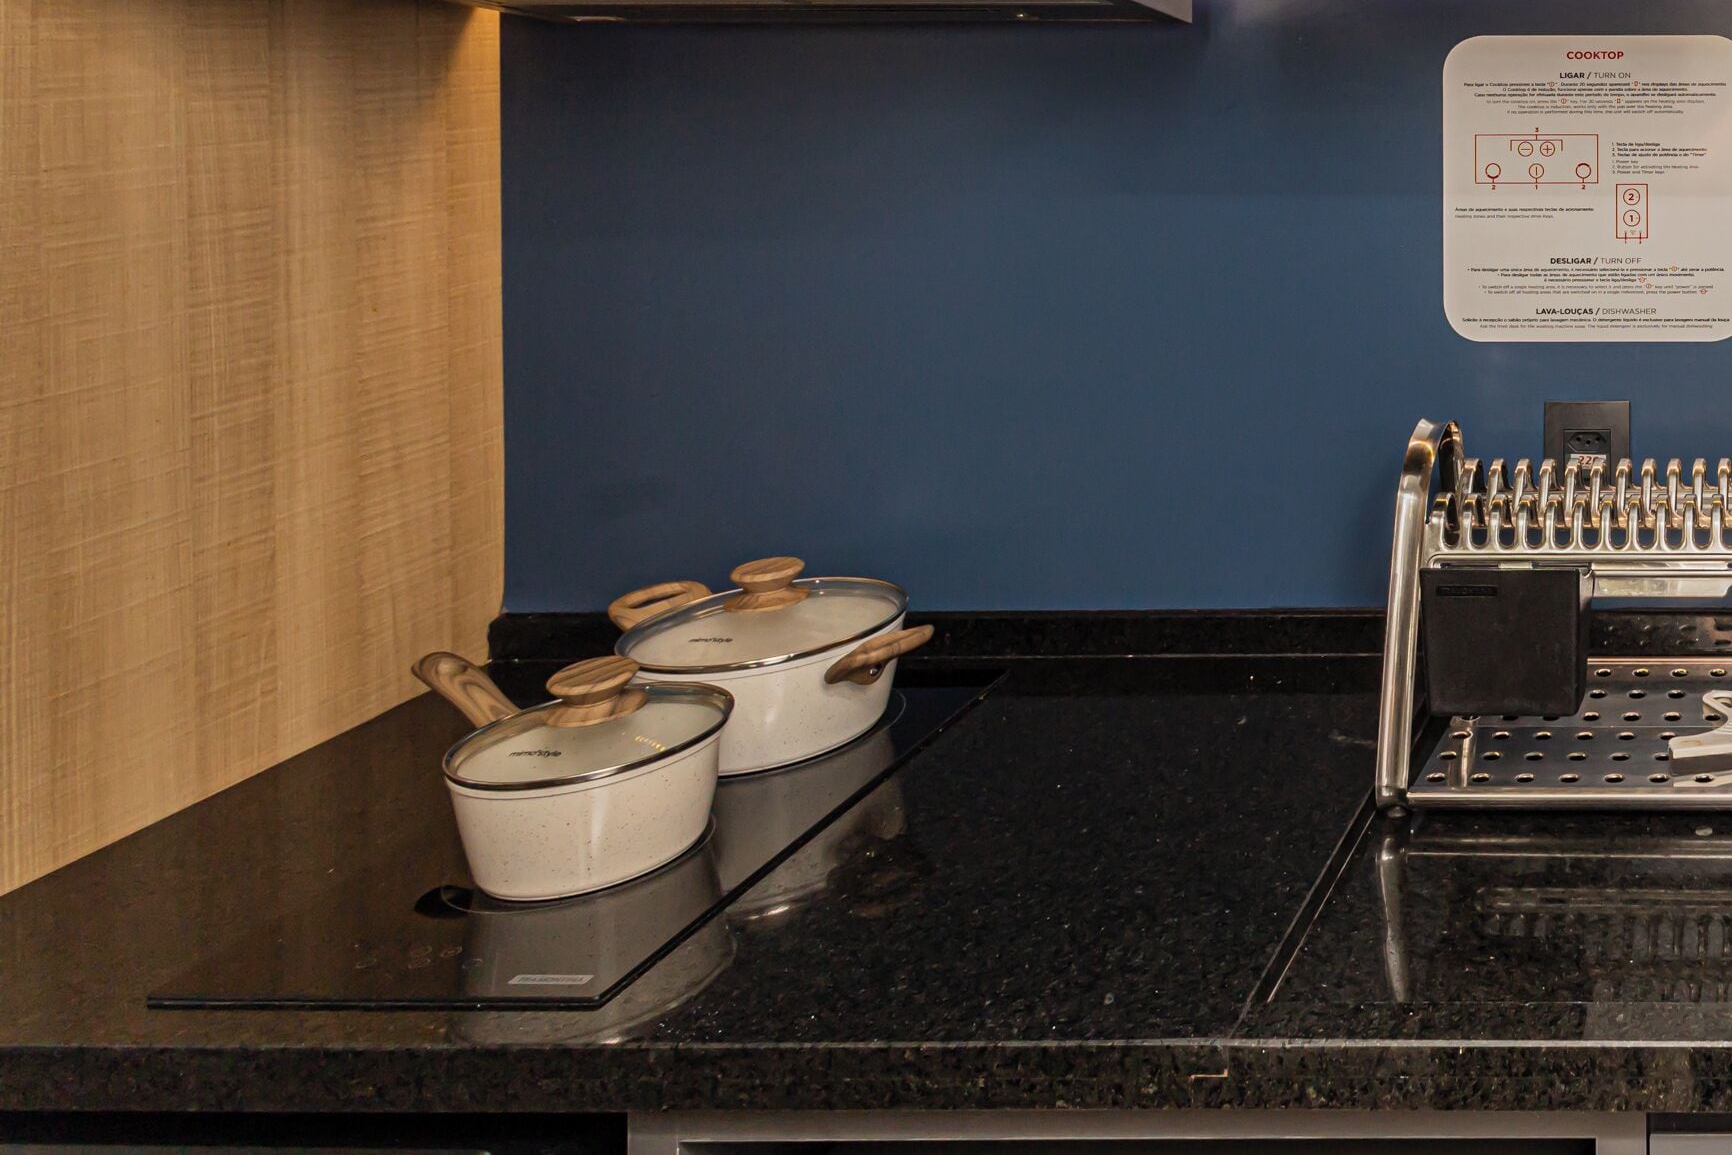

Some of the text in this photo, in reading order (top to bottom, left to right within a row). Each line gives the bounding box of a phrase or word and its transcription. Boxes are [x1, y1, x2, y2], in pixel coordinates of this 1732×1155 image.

[1566, 51, 1624, 60] COOKTOP
[1586, 72, 1592, 80] /
[1628, 193, 1635, 201] 2
[1593, 257, 1599, 265] /
[1536, 308, 1594, 316] LAVA-LOUÇAS
[1595, 307, 1601, 315] /
